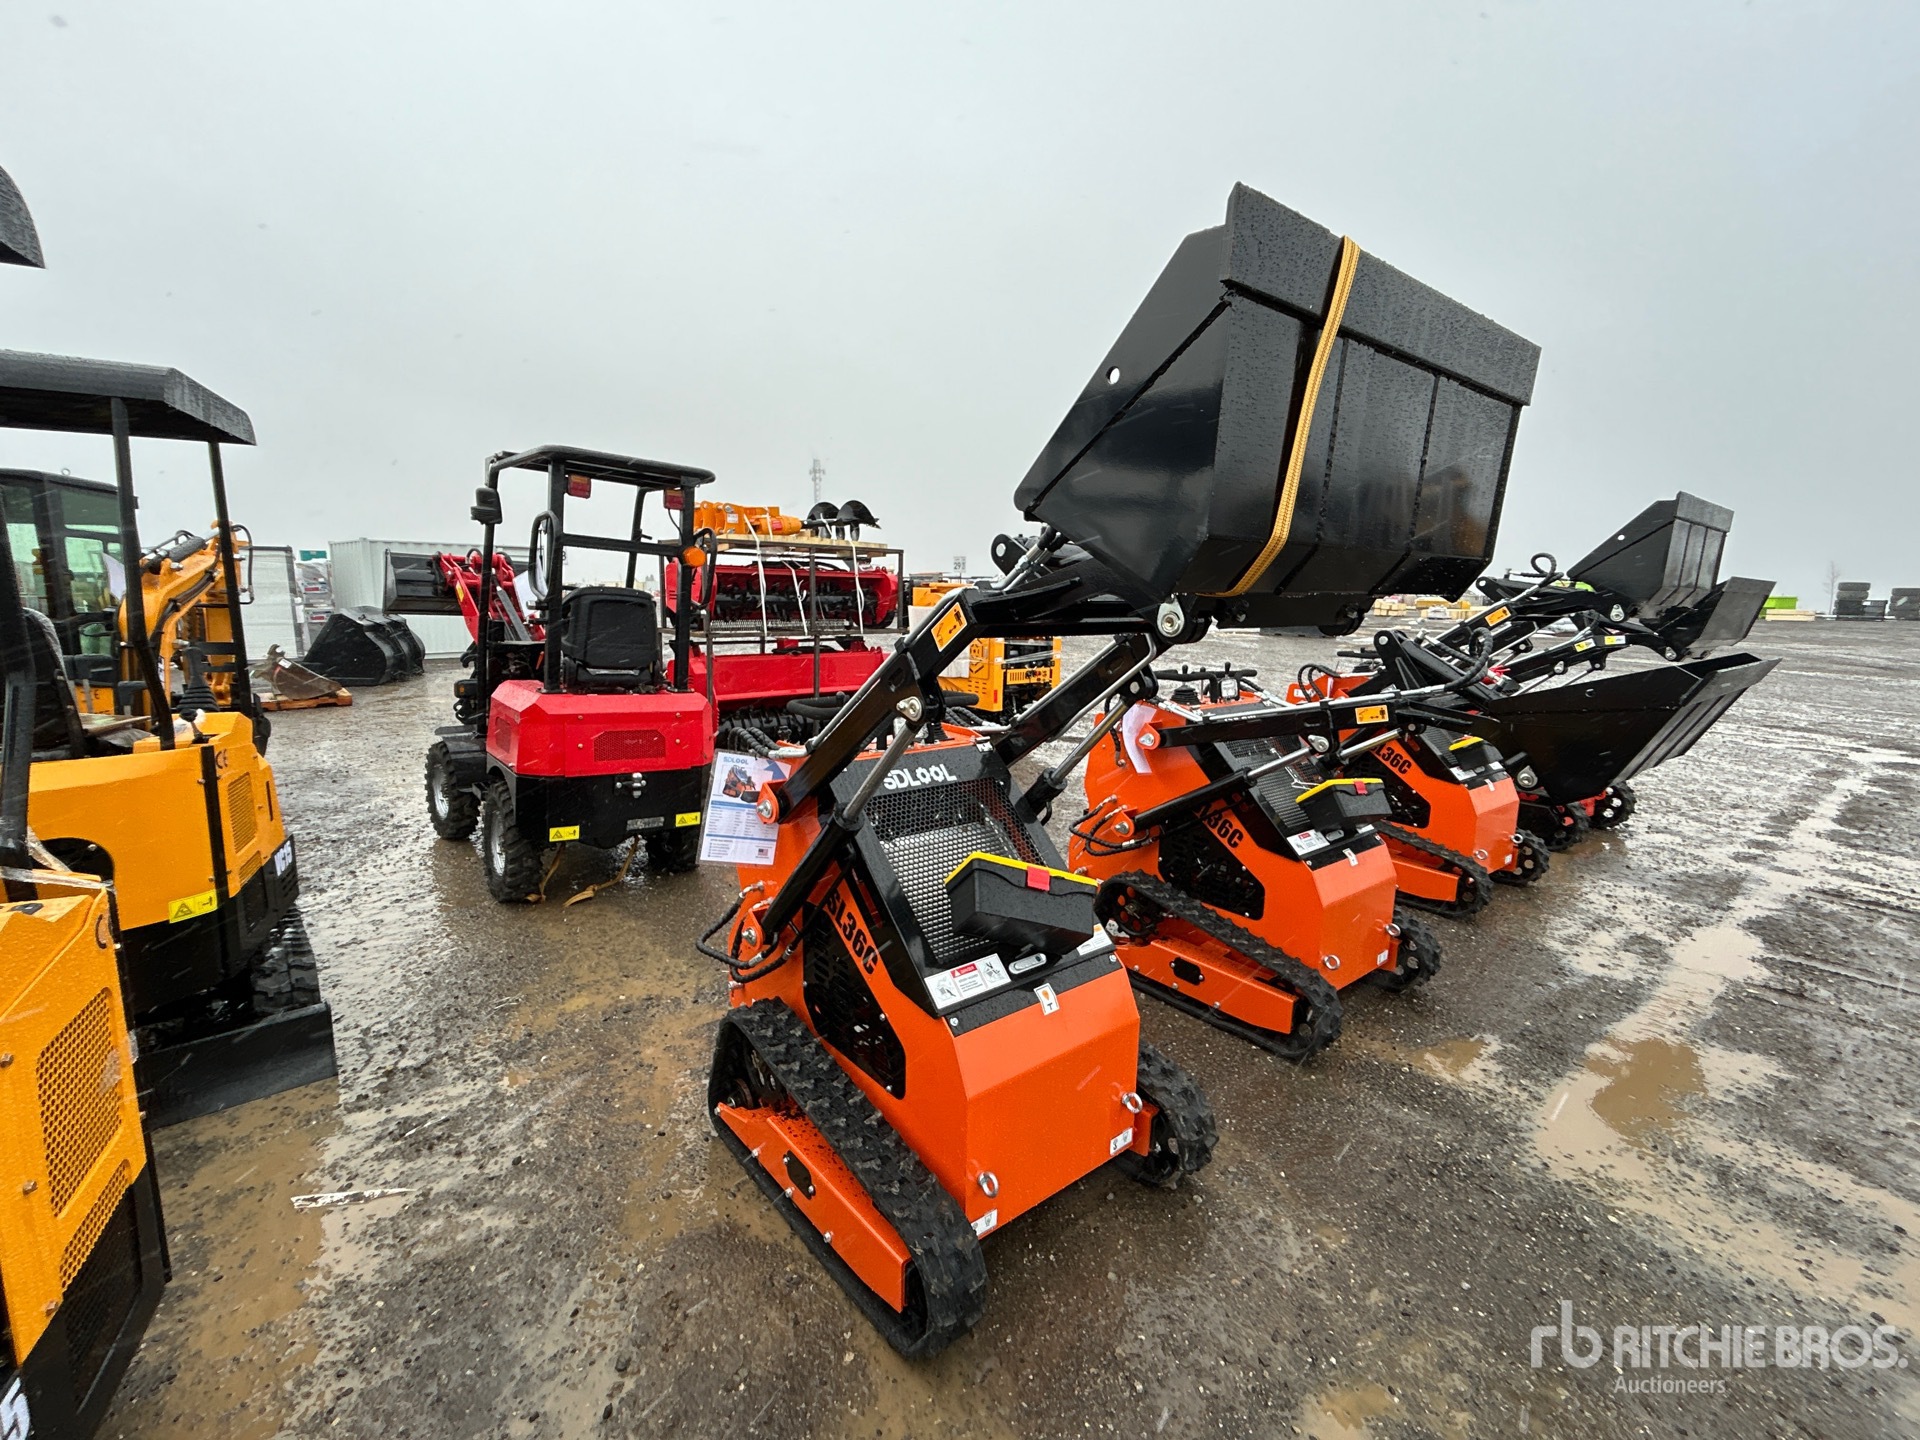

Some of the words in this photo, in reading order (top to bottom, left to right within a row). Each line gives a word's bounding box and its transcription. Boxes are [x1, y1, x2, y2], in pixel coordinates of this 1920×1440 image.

[1370, 743, 1412, 775] L36C
[883, 763, 957, 790] SDLOOL
[824, 886, 879, 975] SL36C
